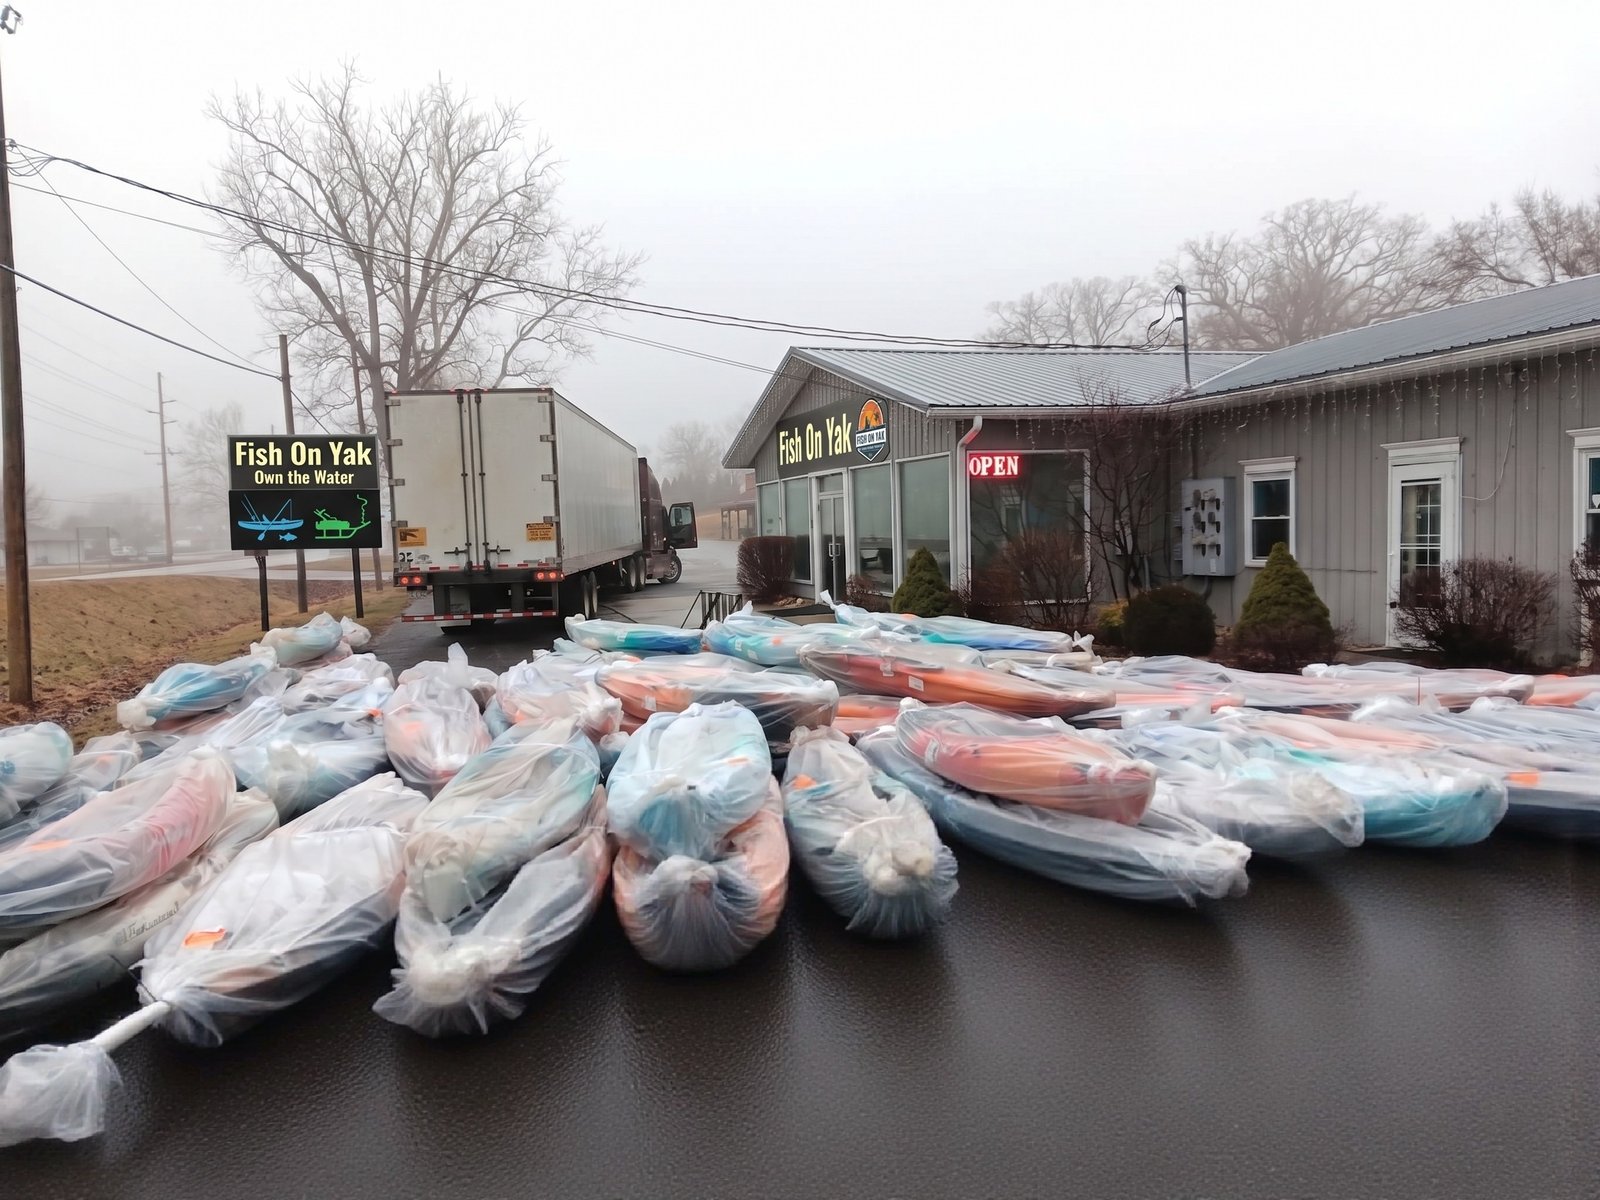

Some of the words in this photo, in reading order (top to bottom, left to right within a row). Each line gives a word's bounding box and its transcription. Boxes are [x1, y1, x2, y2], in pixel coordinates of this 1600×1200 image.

[779, 427, 802, 466] Fish
[805, 423, 823, 461] On
[825, 413, 853, 457] Yak
[857, 433, 868, 445] FISH
[868, 431, 875, 443] ON
[235, 441, 283, 466] Fish
[290, 441, 322, 466] On
[329, 441, 372, 466] Yak
[969, 456, 1019, 476] OPEN
[254, 470, 284, 485] Own
[287, 470, 310, 485] the
[314, 470, 354, 485] Water
